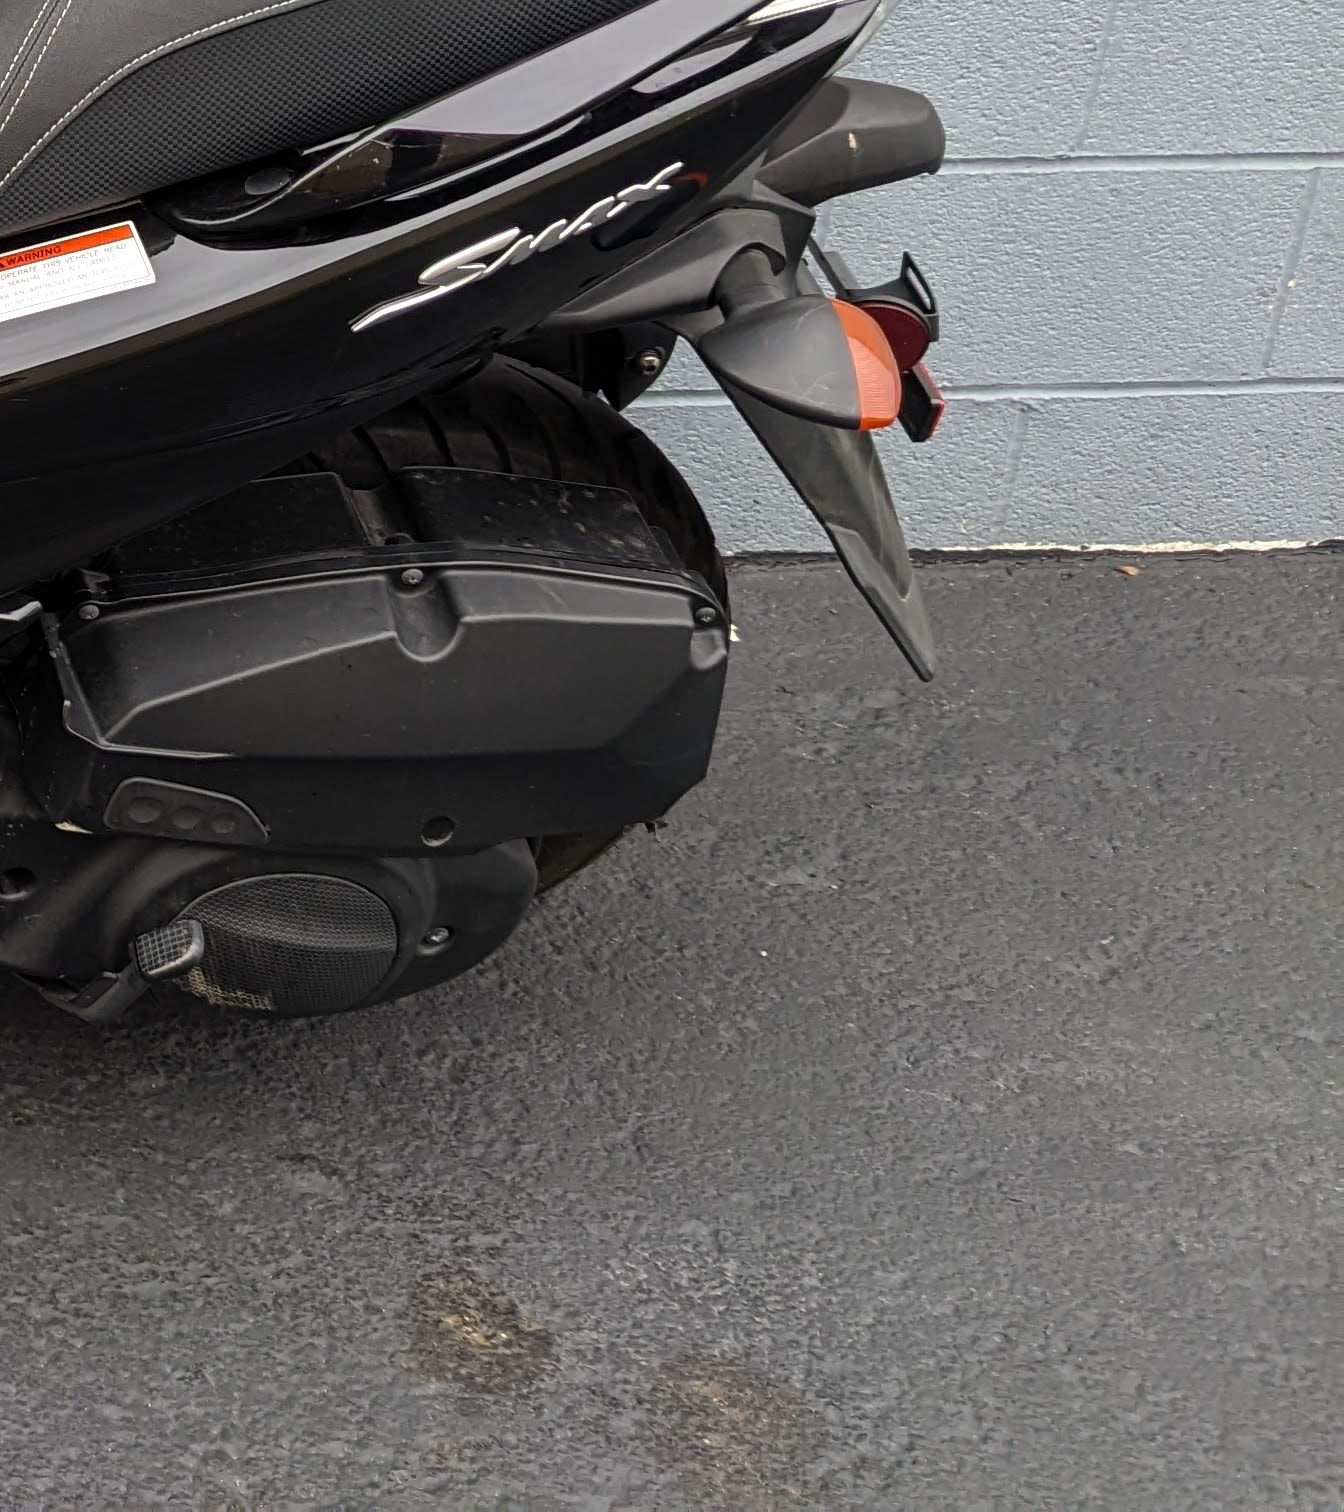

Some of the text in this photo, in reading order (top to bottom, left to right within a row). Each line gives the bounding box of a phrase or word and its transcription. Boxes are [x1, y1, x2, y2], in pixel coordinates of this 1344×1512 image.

[0, 265, 37, 281] OPERATE
[42, 259, 61, 269] THIS
[103, 243, 127, 253] READ
[6, 245, 62, 267] WARNING
[8, 274, 41, 286] MANUAL
[46, 267, 64, 276] AND
